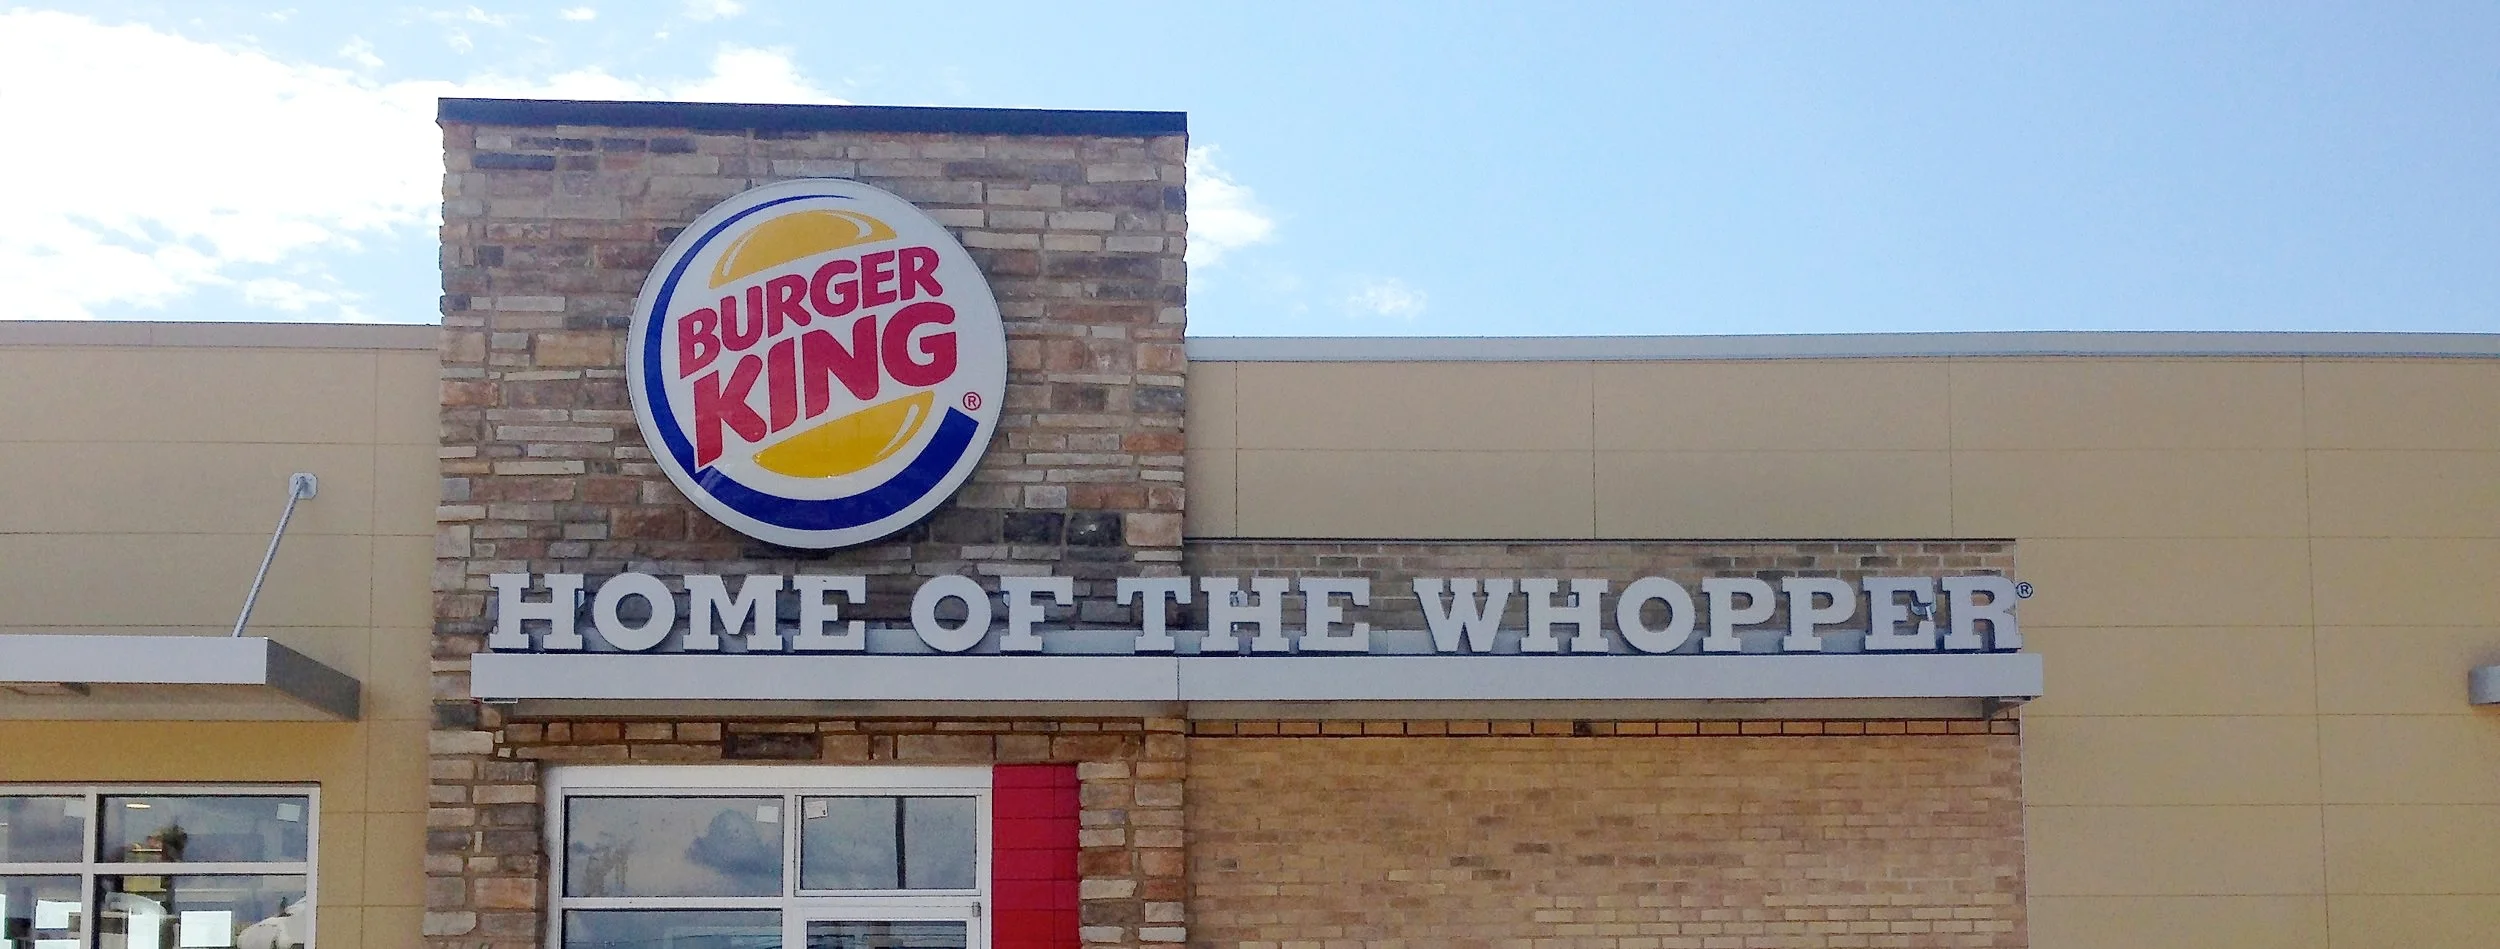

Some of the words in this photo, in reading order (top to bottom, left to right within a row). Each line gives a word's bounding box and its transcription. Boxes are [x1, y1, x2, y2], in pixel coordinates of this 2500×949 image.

[678, 246, 943, 379] BURGER
[693, 301, 957, 468] KING
[489, 572, 867, 652] HOME
[911, 574, 1074, 652] OF
[1116, 575, 1371, 653] THE
